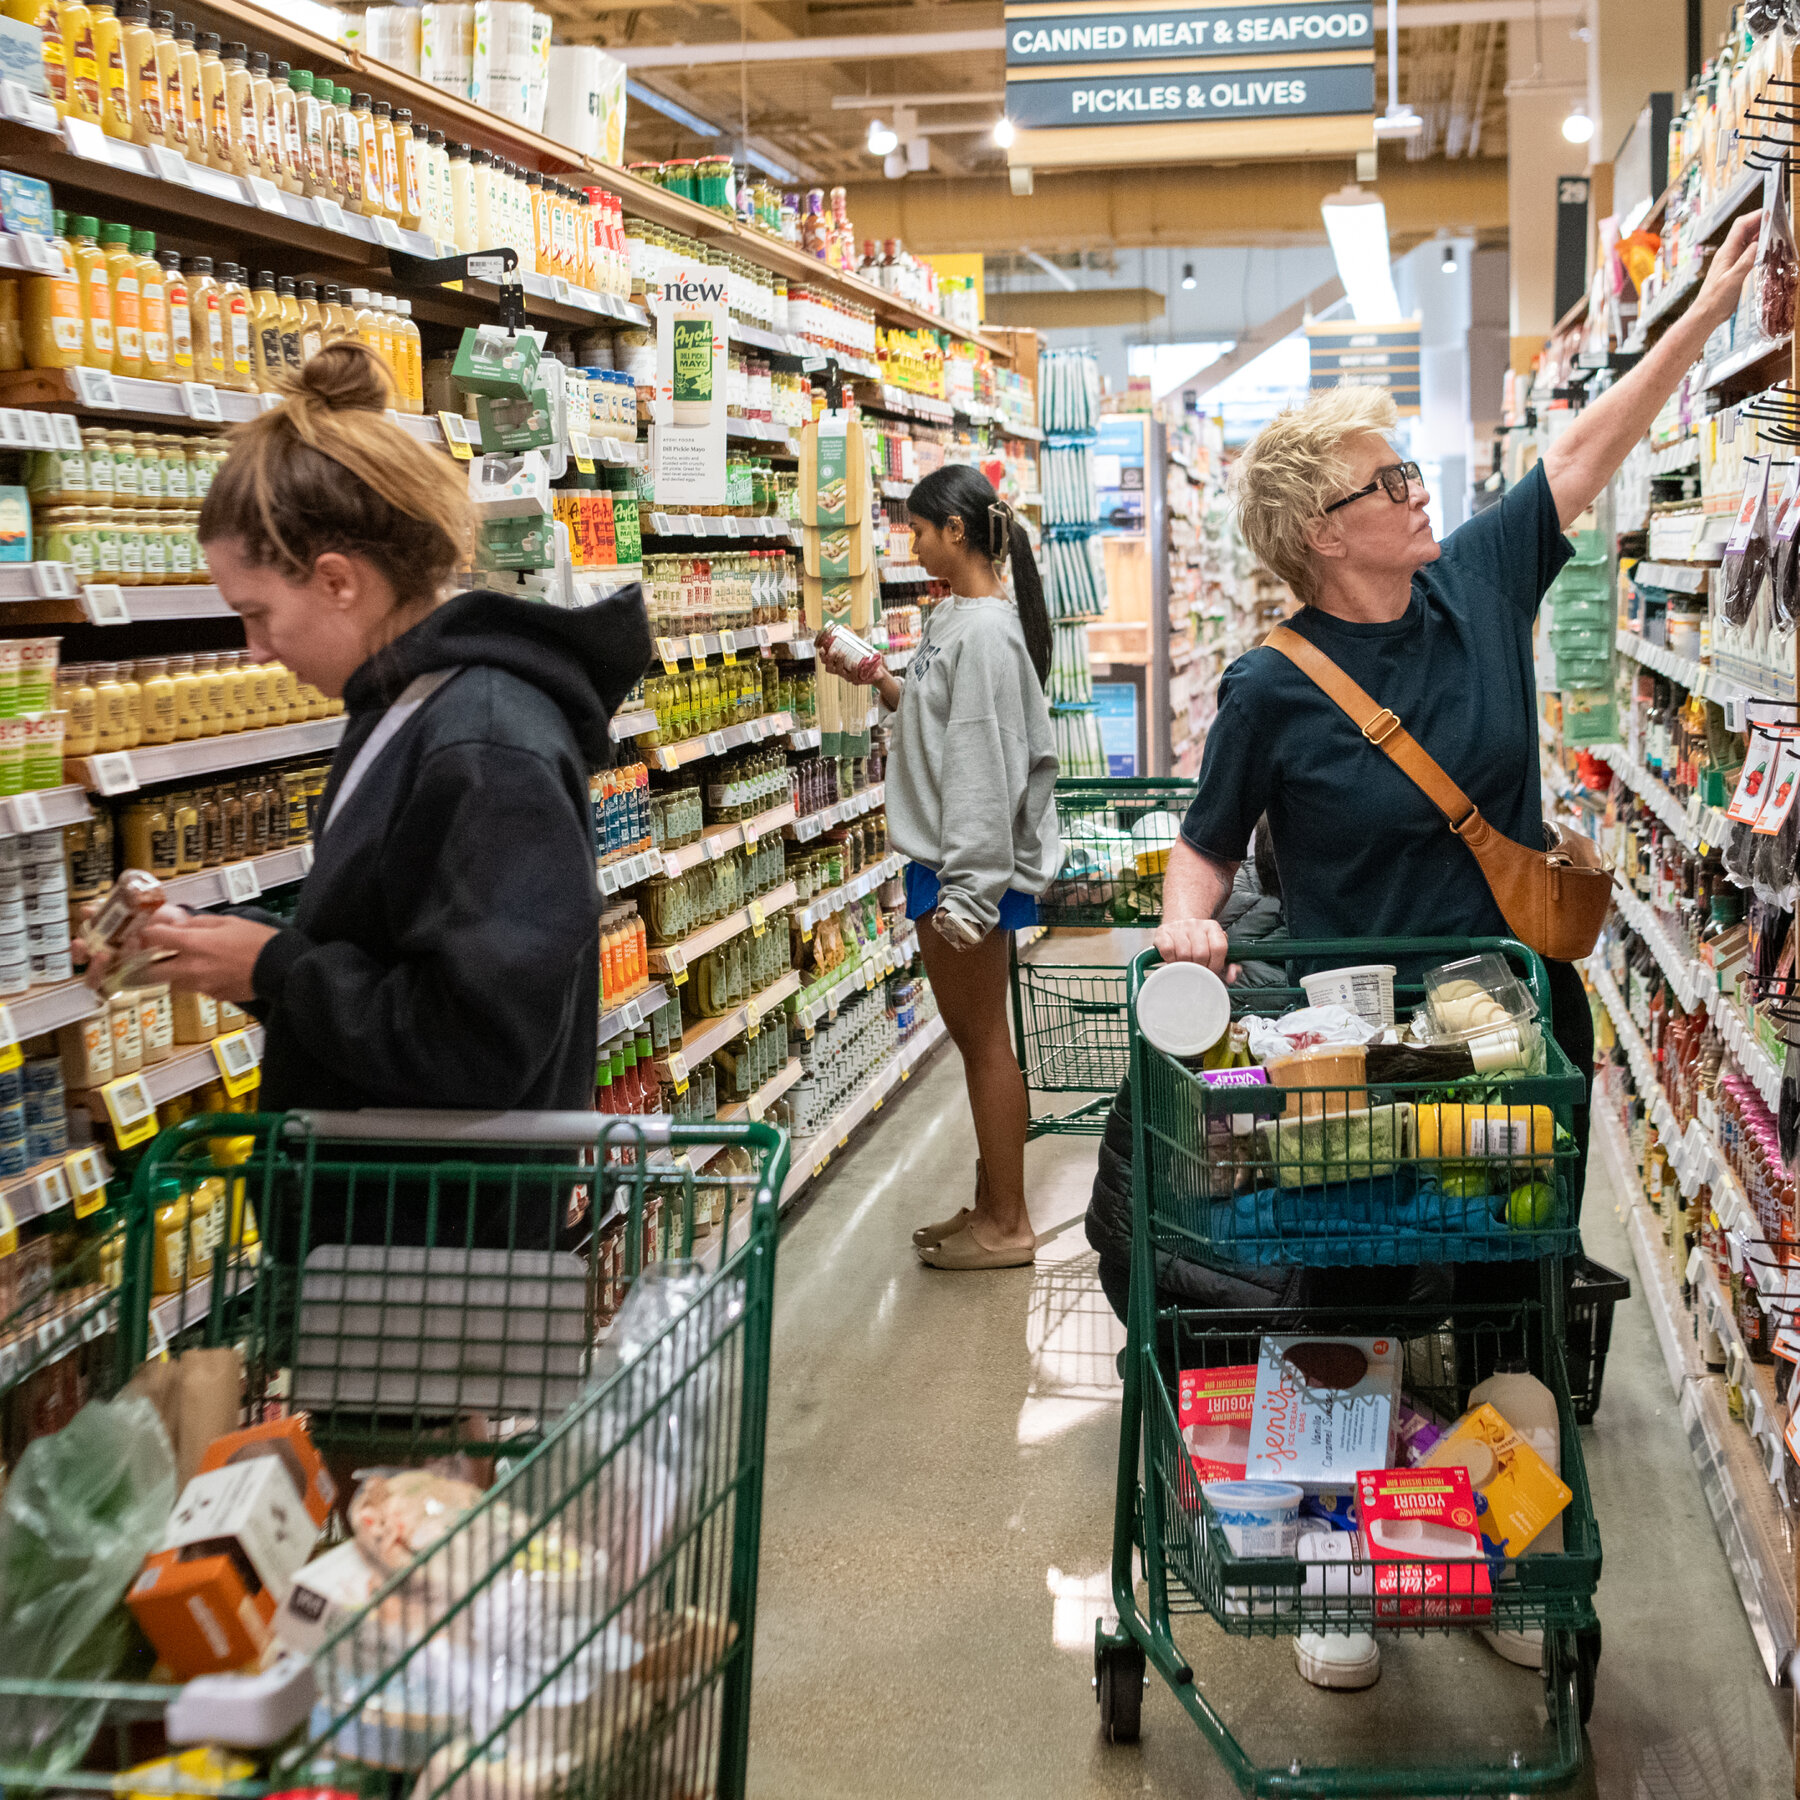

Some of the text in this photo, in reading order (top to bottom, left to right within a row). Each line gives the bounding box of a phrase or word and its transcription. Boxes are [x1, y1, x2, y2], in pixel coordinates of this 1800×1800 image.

[1012, 13, 1369, 54] CANNED MEAT & SEAFOOD
[1072, 80, 1307, 113] PICKLES & OLIVES
[663, 283, 724, 302] new
[679, 360, 708, 368] MAYO
[1207, 1396, 1255, 1414] YOGURT
[1311, 1414, 1322, 1446] Vanilla
[1322, 1428, 1333, 1468] Caramel
[1393, 1494, 1446, 1509] YOGURT
[1399, 1508, 1443, 1517] STRAWBERRY
